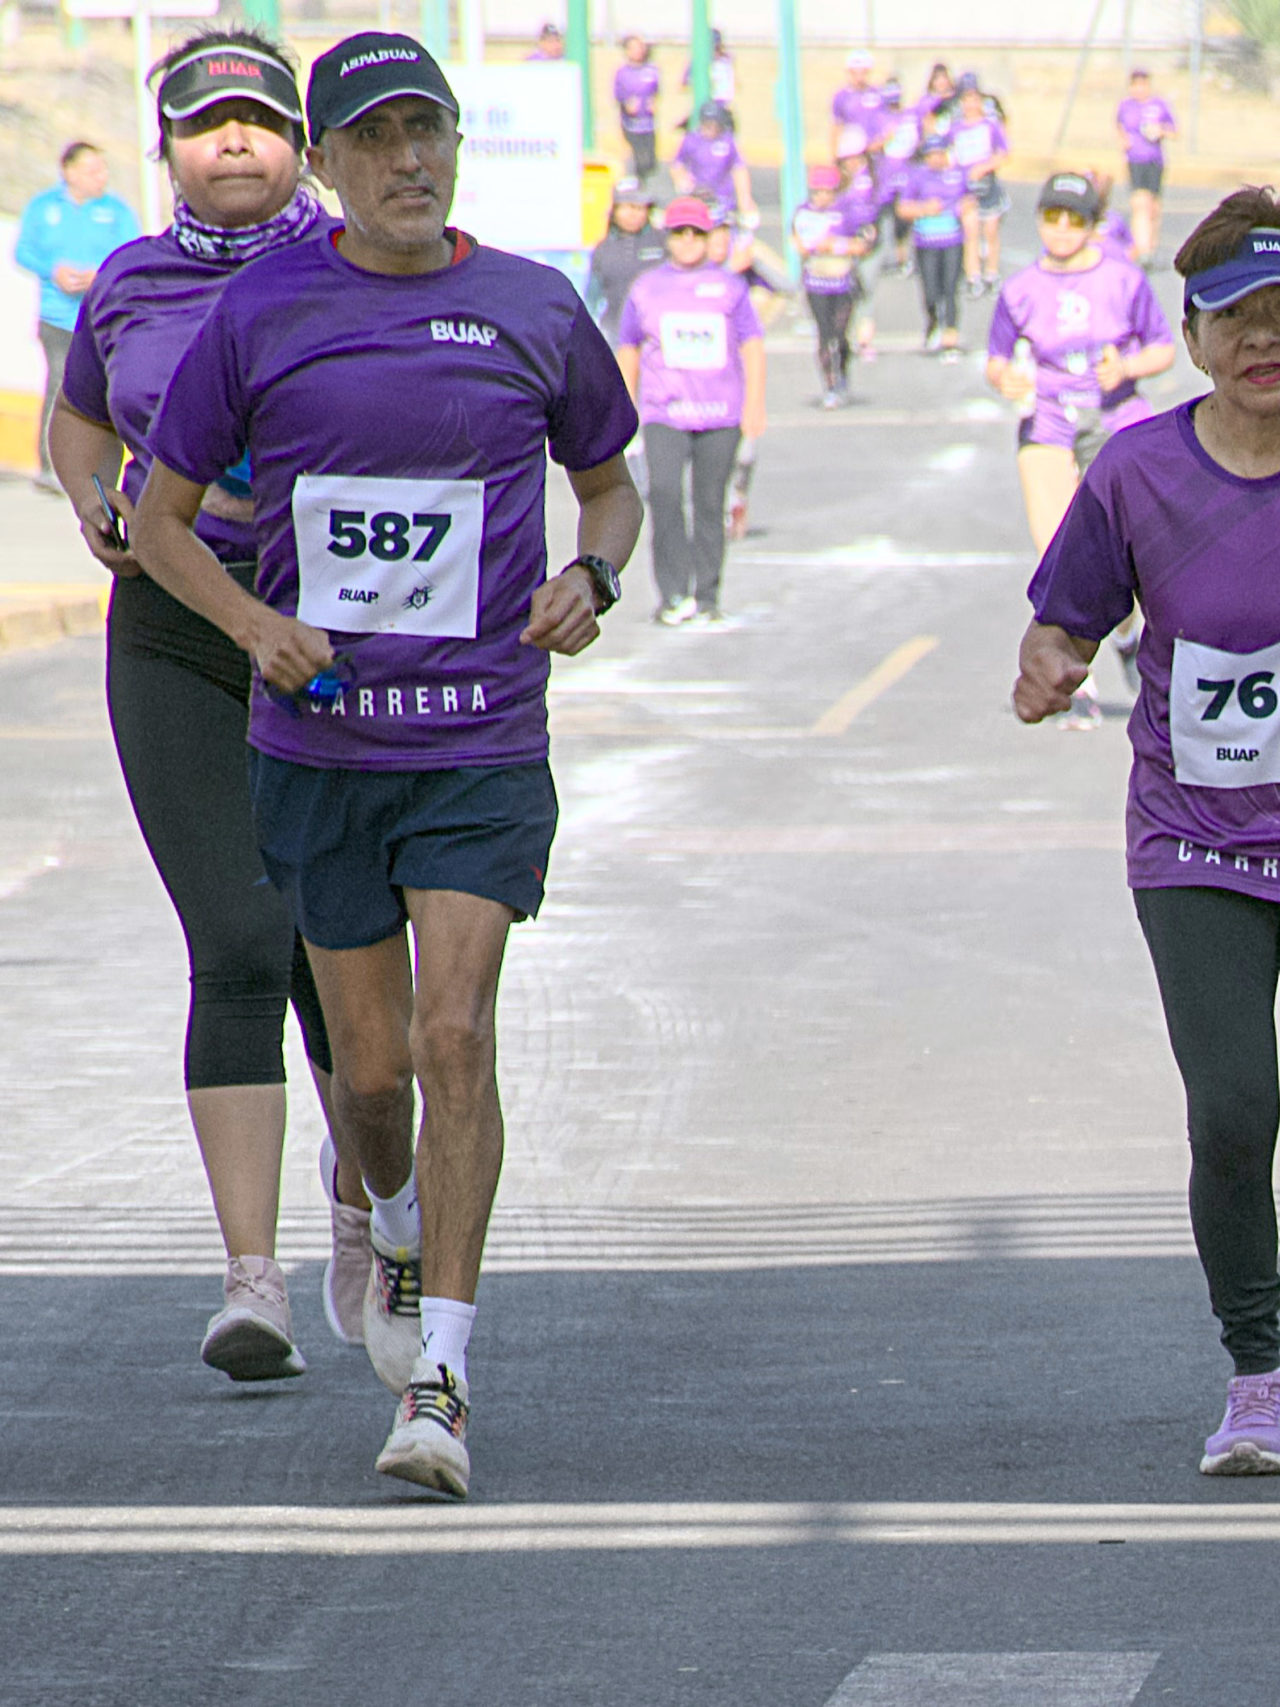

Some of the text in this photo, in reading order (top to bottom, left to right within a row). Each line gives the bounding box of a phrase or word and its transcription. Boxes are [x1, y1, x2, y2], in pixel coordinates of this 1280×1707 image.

[430, 319, 498, 347] BUAP
[327, 508, 452, 562] 587
[338, 587, 379, 604] BUAP
[1216, 747, 1260, 762] BUAP
